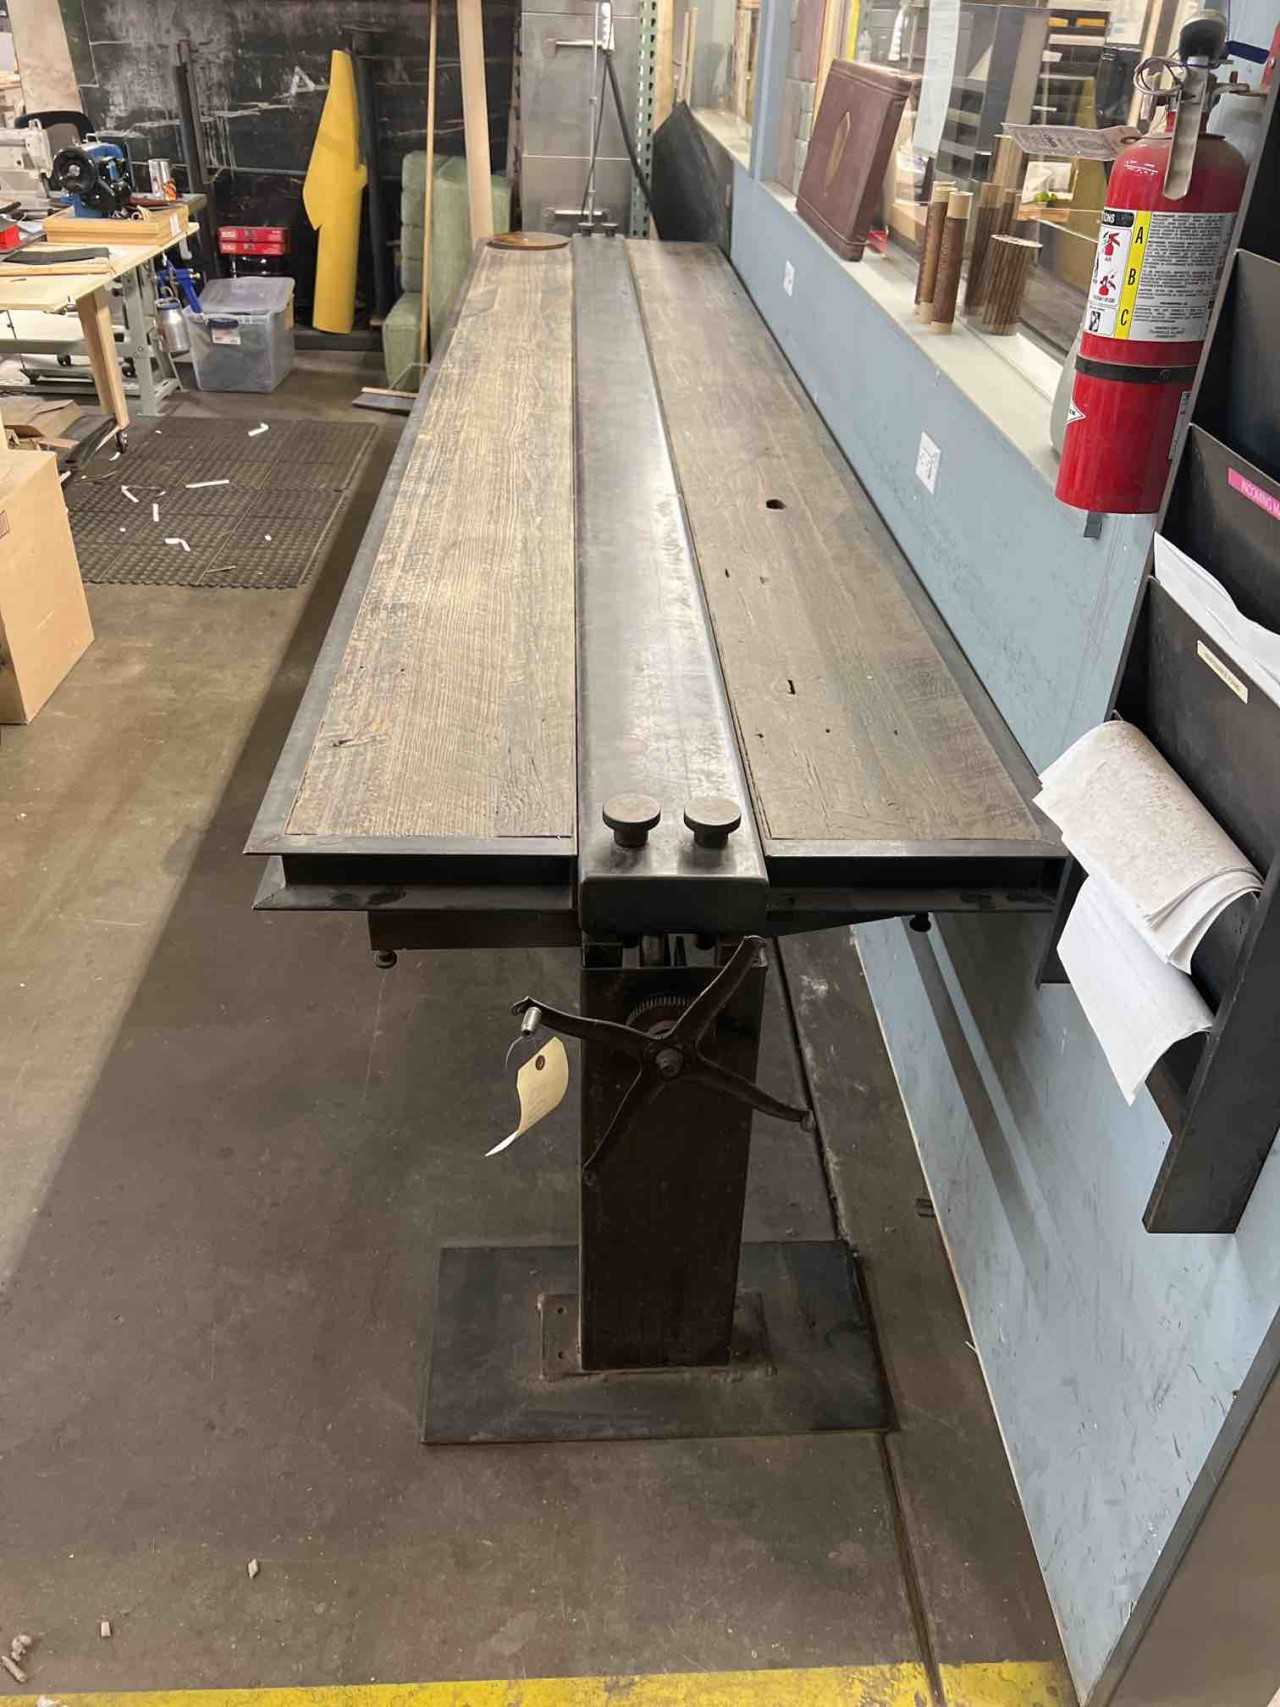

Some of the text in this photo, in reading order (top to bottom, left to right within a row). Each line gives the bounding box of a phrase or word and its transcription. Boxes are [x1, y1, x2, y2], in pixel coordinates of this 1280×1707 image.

[1135, 226, 1144, 244] A
[1127, 268, 1137, 286] B
[1120, 309, 1129, 326] C
